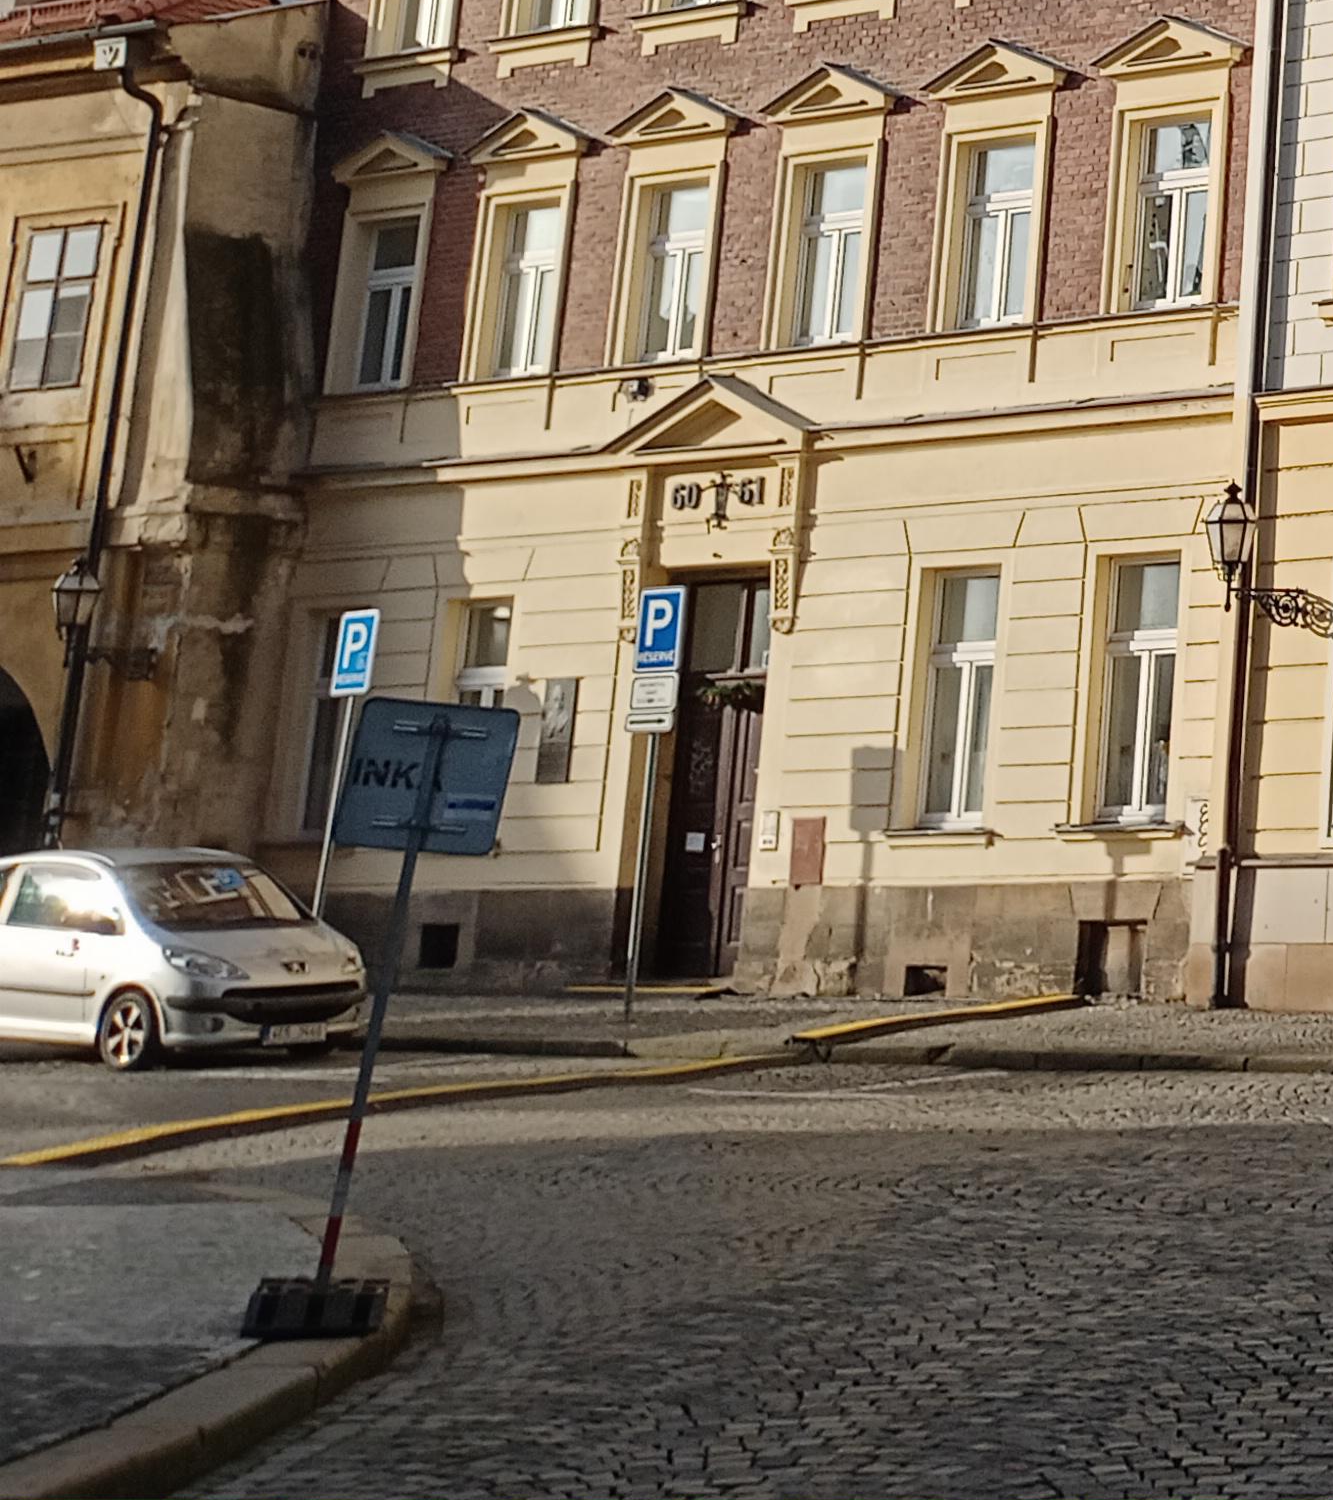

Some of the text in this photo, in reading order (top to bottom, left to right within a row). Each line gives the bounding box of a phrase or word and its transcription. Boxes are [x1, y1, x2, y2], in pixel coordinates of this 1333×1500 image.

[671, 476, 766, 511] 60 61
[342, 622, 368, 669] P
[644, 598, 674, 648] P
